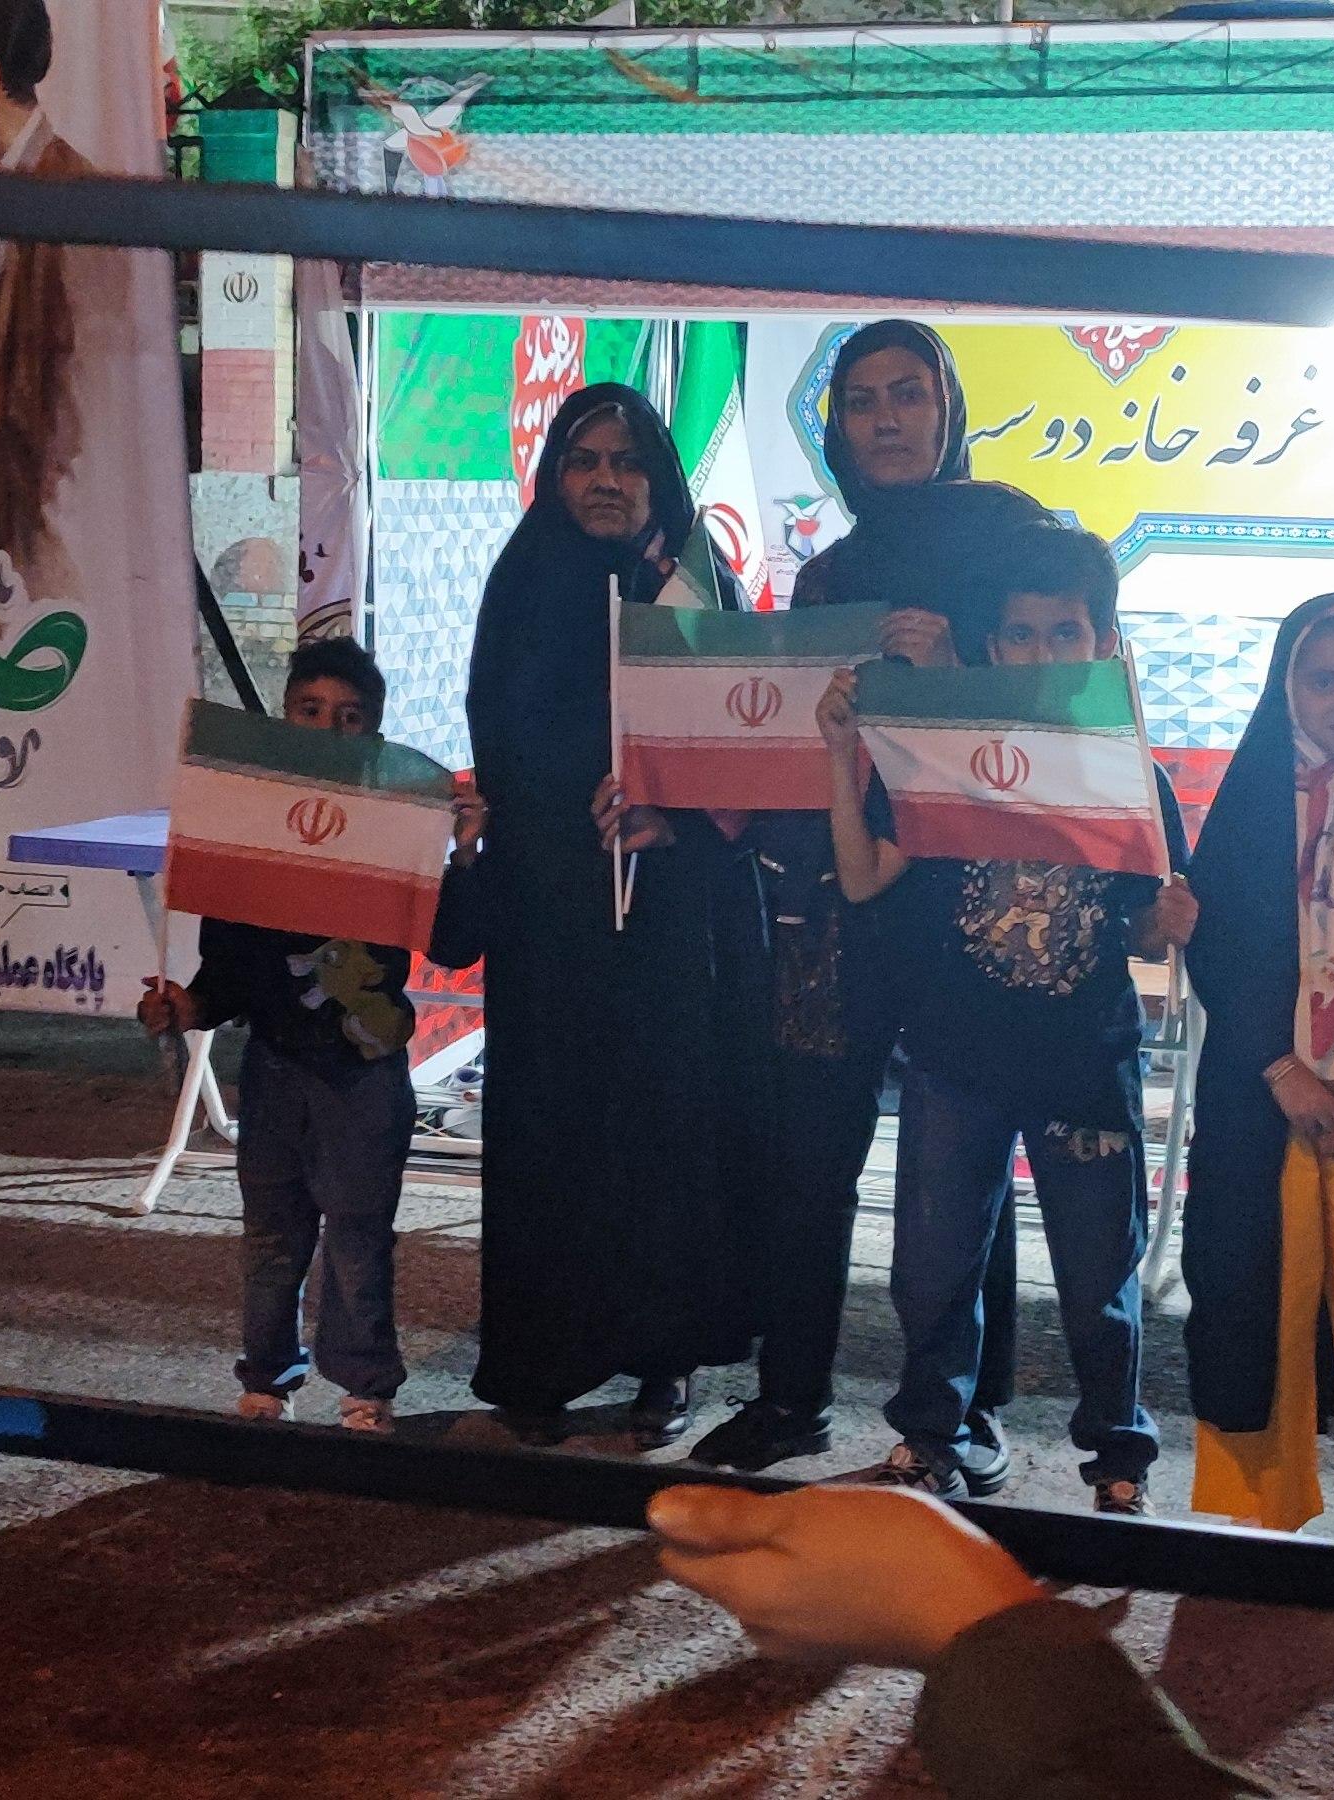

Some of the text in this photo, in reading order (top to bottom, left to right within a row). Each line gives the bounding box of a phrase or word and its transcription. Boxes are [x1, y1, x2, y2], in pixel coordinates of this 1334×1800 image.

[967, 364, 1324, 467] غرفه خانه دوس
[43, 943, 105, 1010] پایگاه
